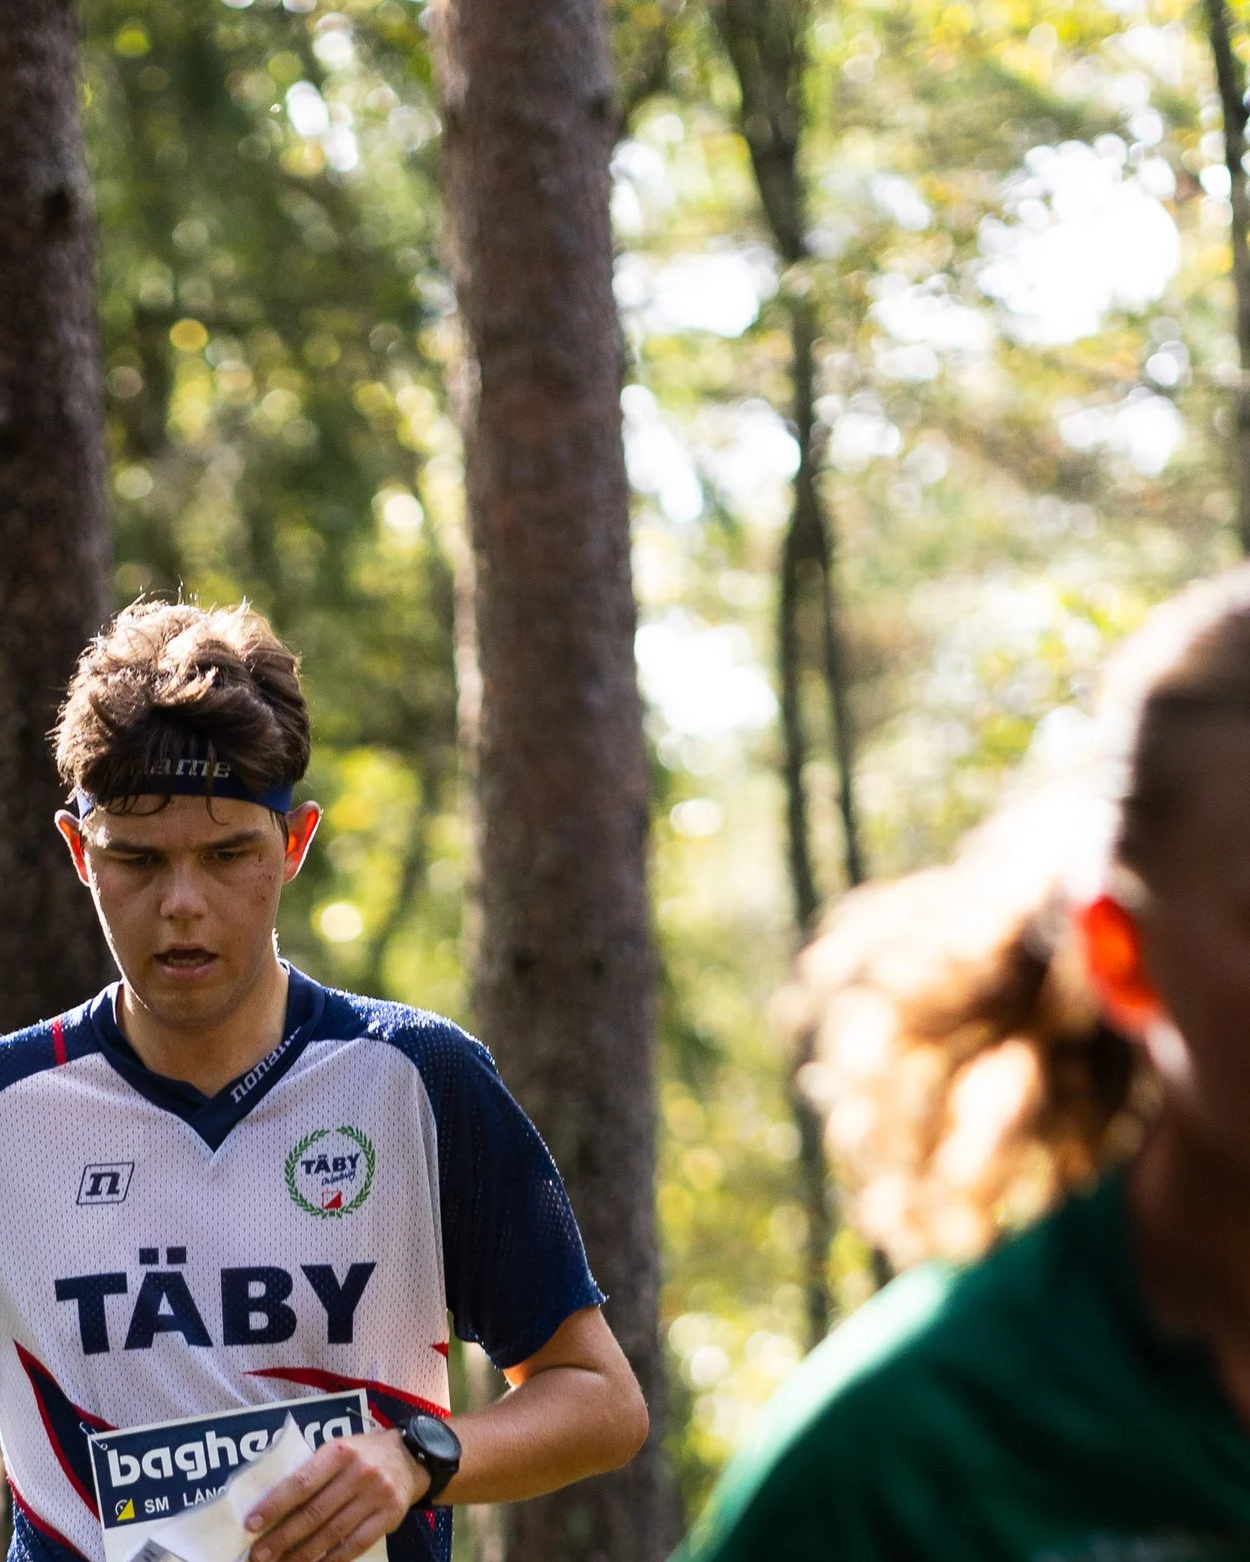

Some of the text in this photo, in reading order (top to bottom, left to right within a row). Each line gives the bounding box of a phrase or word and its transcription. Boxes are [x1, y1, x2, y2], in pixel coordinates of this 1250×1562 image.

[300, 1152, 361, 1175] TÄBY
[54, 1246, 377, 1355] TÄBY
[107, 1416, 353, 1488] baghera
[144, 1495, 170, 1514] SM
